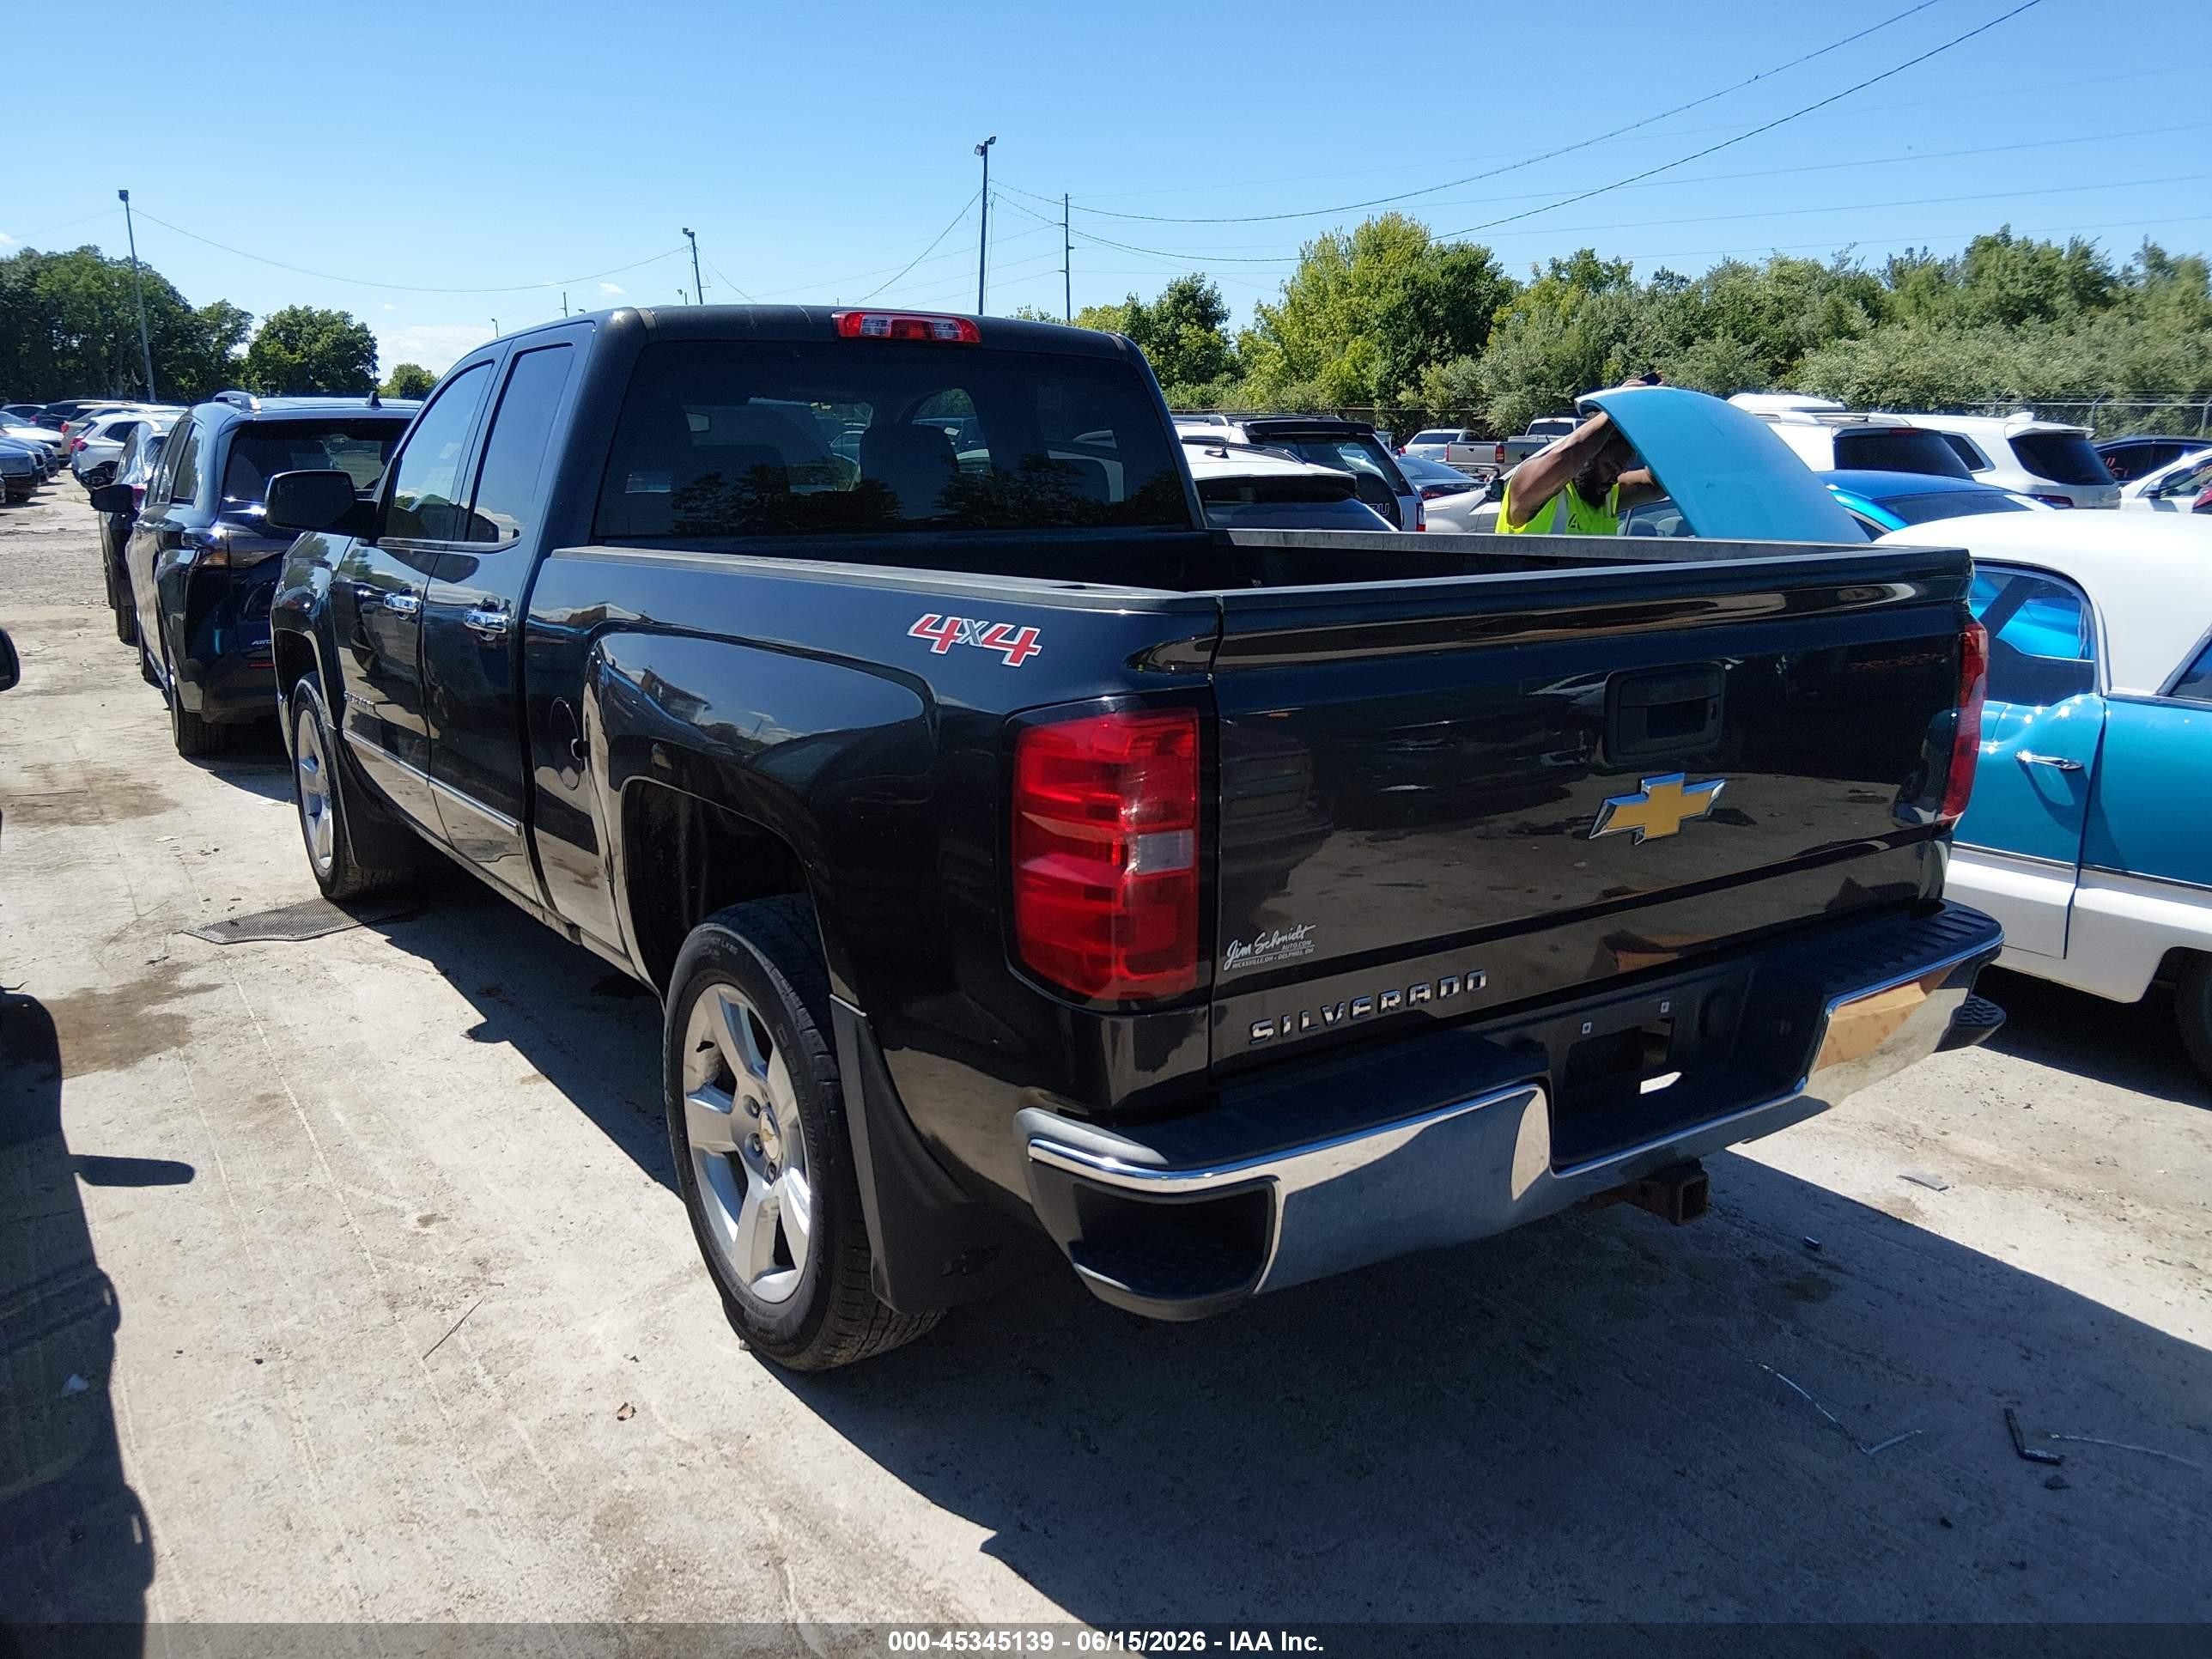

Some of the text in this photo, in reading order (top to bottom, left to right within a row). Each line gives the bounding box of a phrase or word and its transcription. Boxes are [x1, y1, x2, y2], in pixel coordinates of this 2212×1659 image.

[1224, 923, 1316, 970] Jim Schmidt
[1249, 969, 1487, 1044] SILVERADO
